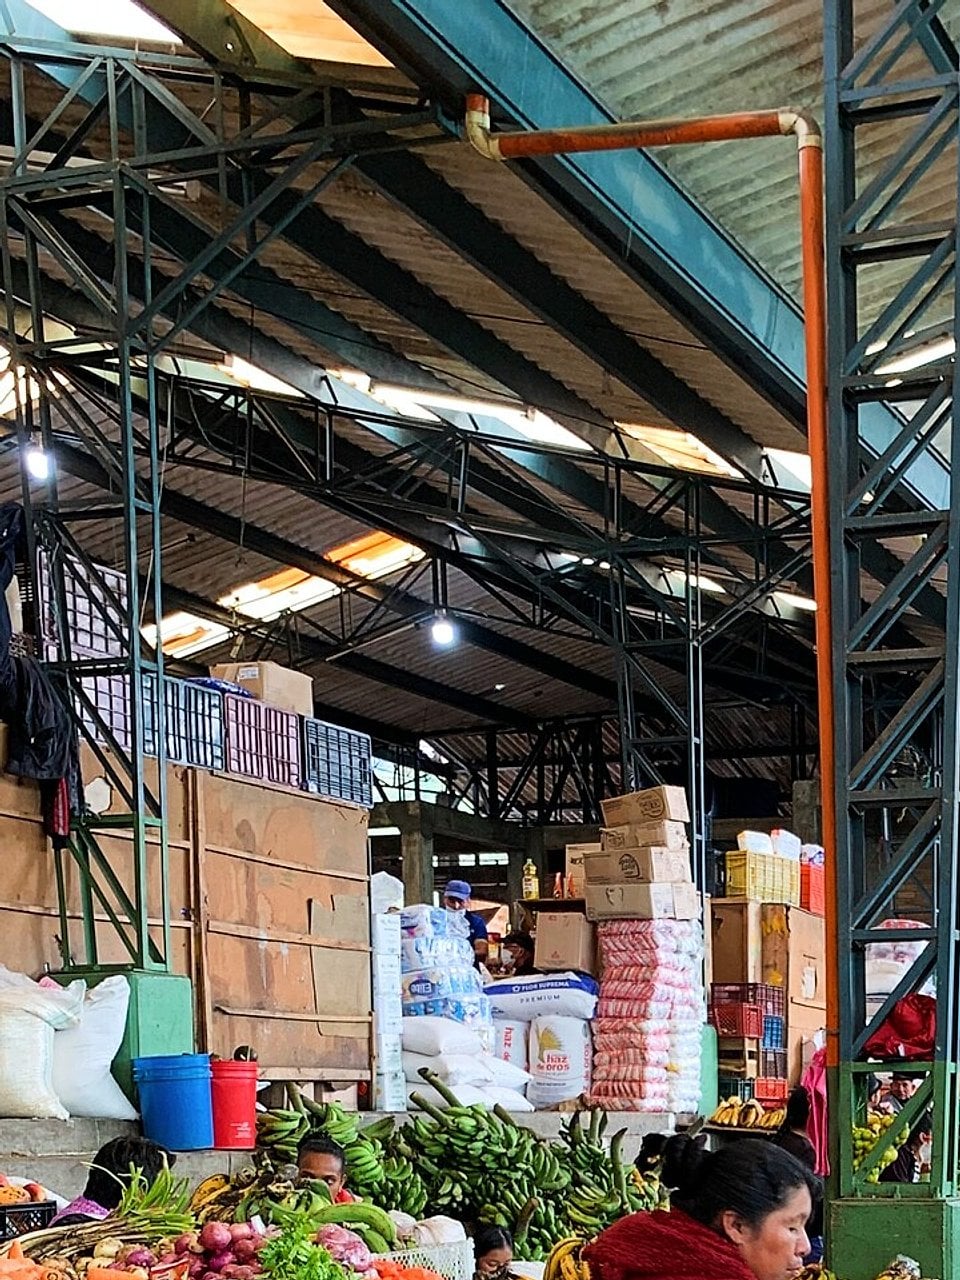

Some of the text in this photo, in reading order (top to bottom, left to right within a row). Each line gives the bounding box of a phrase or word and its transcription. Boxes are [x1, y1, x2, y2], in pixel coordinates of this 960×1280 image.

[521, 981, 570, 991] FLOR SUPREMA
[520, 994, 560, 1003] PREMIUM
[546, 1054, 568, 1064] haz
[546, 1063, 570, 1071] oros
